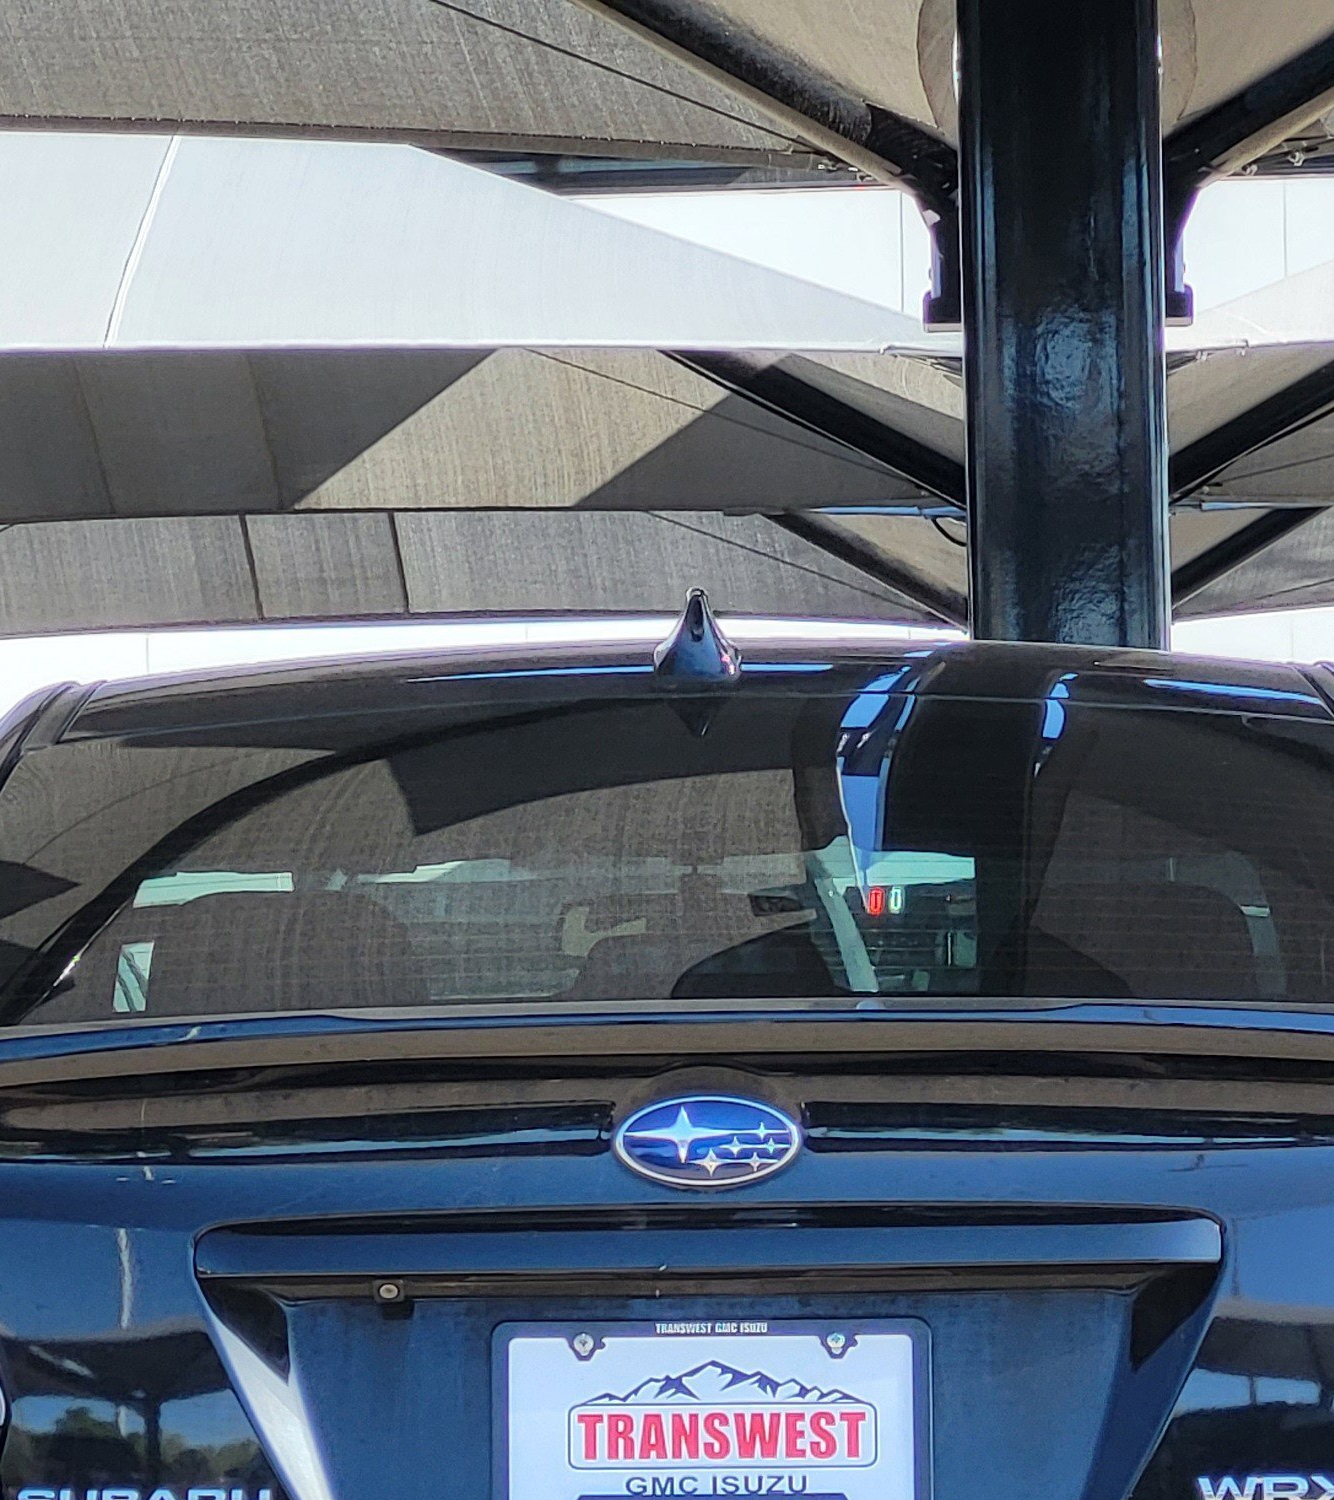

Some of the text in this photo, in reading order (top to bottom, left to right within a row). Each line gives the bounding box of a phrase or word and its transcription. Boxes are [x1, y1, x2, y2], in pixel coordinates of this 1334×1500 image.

[655, 1321, 768, 1334] TRANSWEST GMC ISUZU
[577, 1411, 867, 1461] TRANSWEST
[625, 1475, 808, 1496] GMC ISUZU
